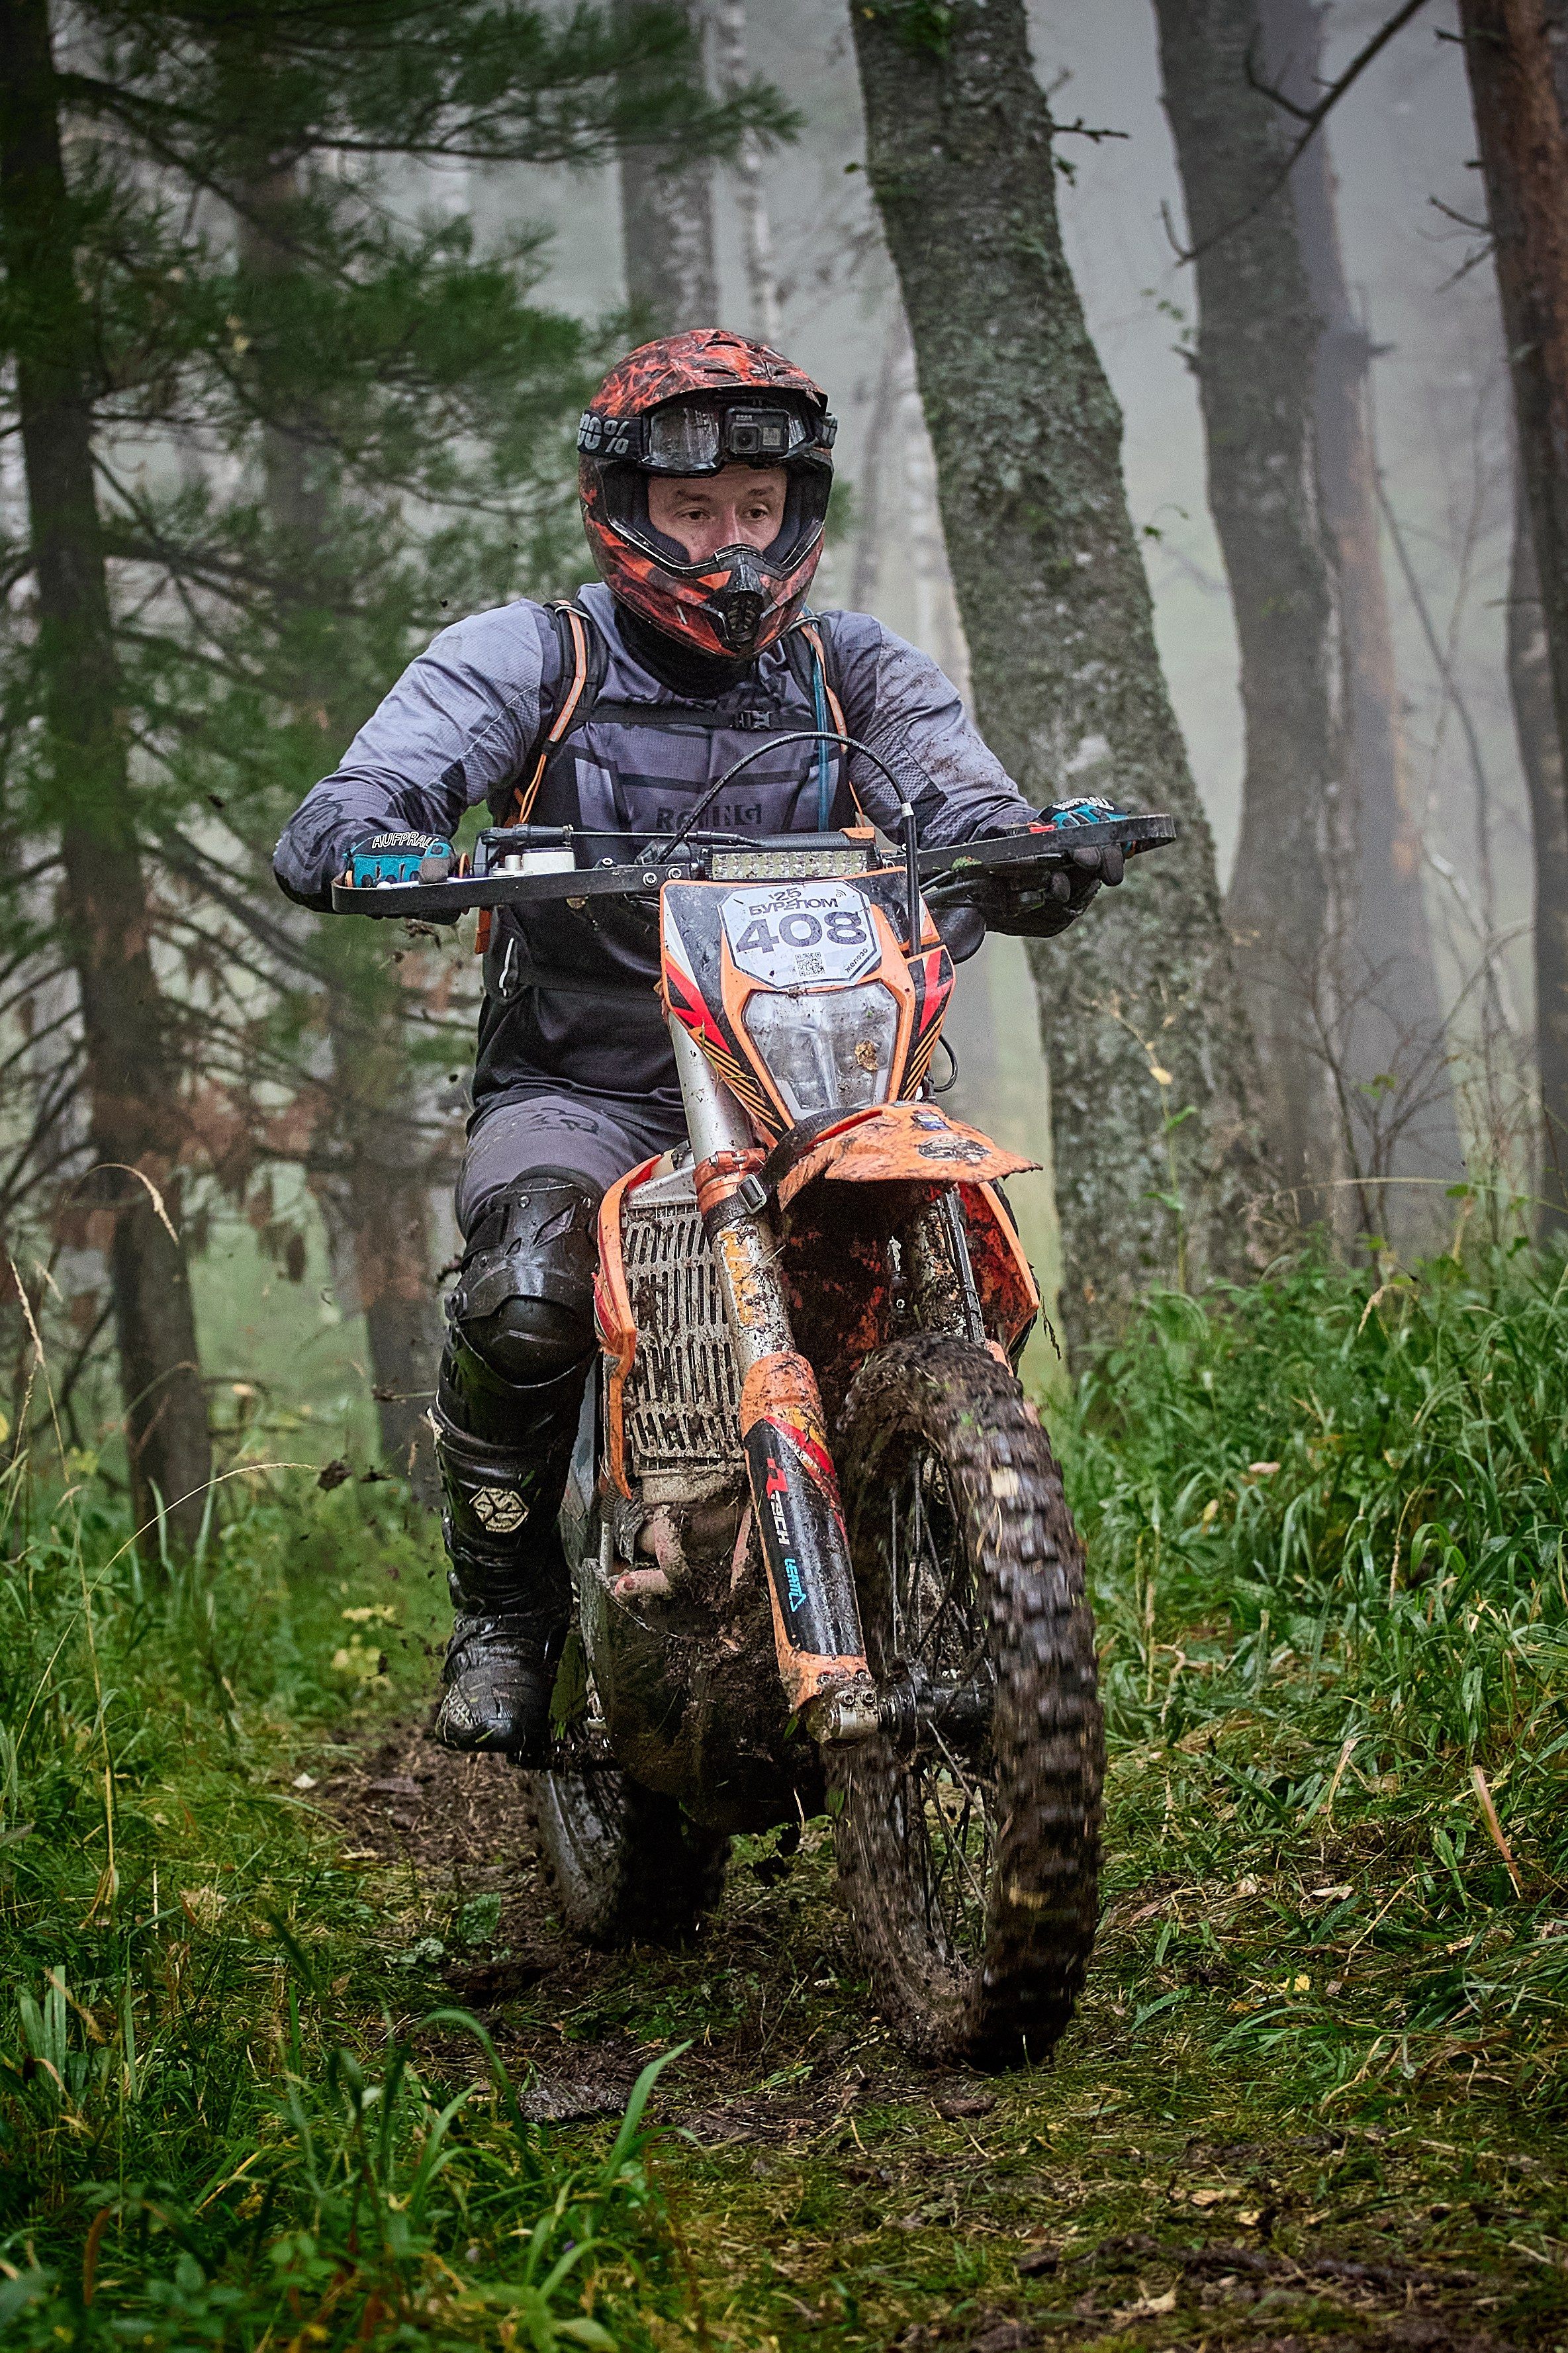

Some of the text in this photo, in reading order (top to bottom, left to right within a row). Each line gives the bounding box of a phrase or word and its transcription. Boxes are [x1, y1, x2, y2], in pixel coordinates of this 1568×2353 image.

[576, 413, 629, 454] 00%
[735, 911, 867, 953] 408
[845, 948, 868, 973] железо
